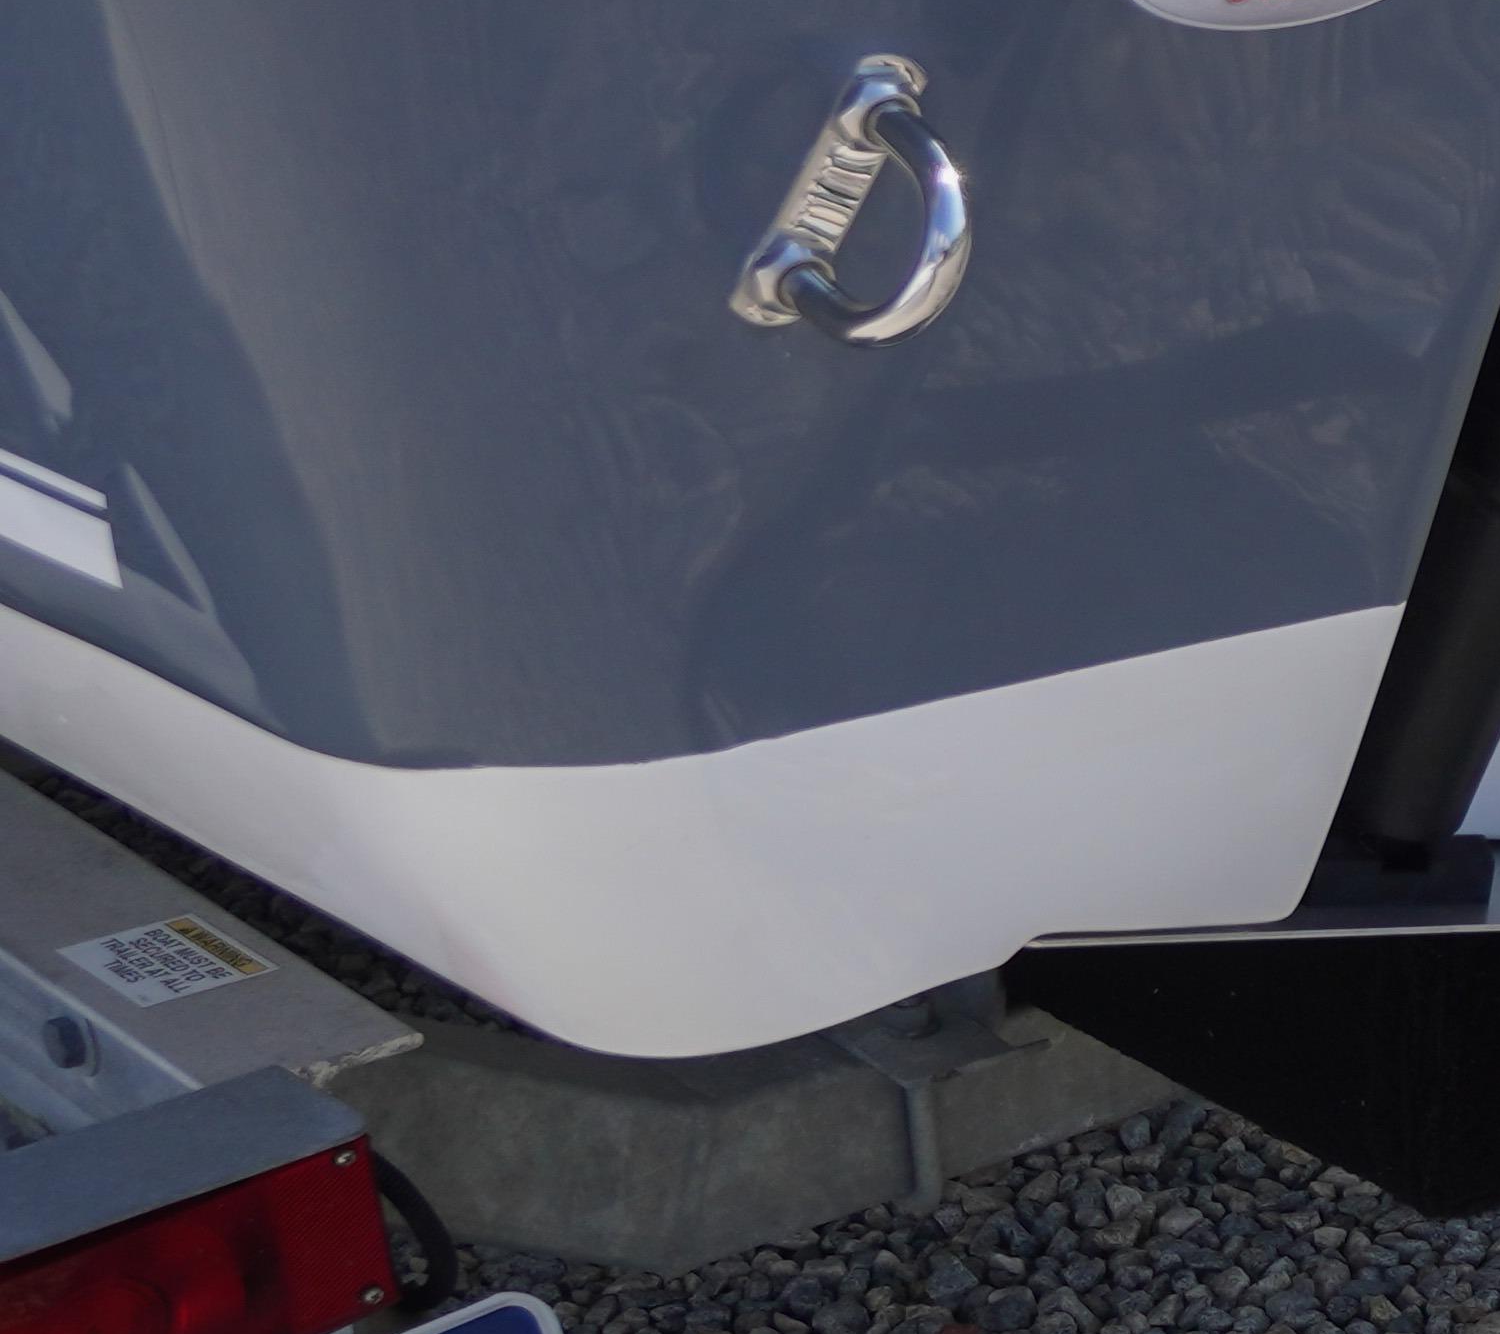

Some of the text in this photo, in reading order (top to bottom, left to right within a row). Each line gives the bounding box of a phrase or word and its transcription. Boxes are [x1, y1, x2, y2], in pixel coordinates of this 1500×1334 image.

[100, 937, 193, 993] TRAILER AT ALL
[127, 937, 206, 983] SECURED TO
[143, 928, 234, 980] BOAT MUST BE
[193, 928, 252, 968] WARNING
[103, 959, 147, 984] TIMES
